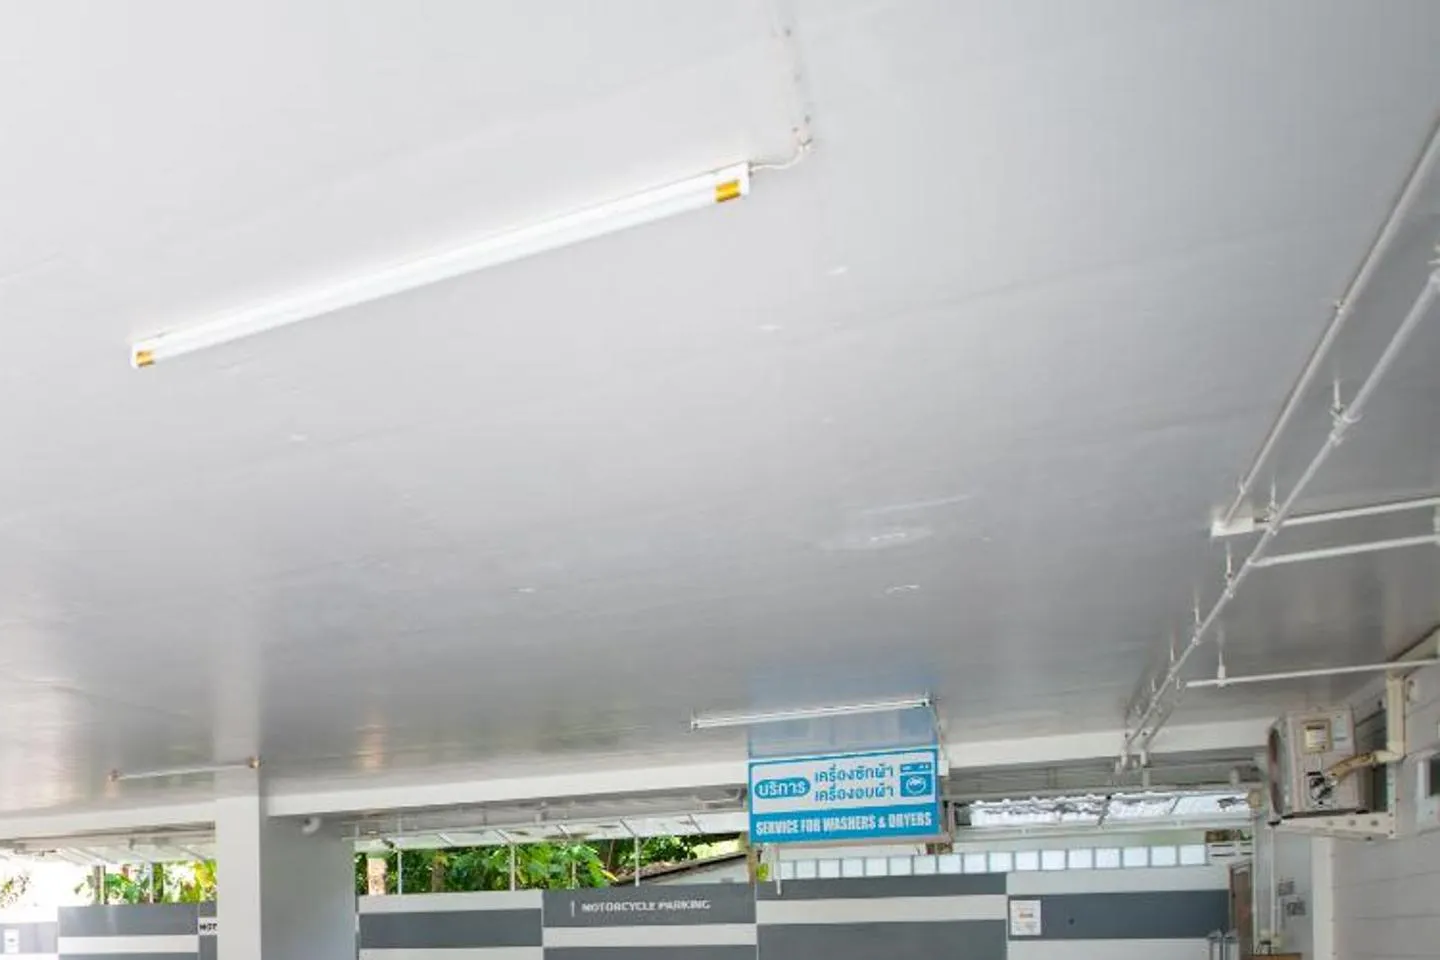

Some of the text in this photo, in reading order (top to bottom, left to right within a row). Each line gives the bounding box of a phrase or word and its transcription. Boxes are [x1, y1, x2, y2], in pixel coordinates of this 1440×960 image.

[814, 763, 894, 782] เครื่องซักผ้า
[759, 779, 806, 796] บริการ
[814, 783, 894, 801] เครื่องอบผ้า
[756, 811, 932, 835] SERVICE FOR WASHERS & DRYERS
[581, 900, 711, 912] MOTORCYCLE PARKING
